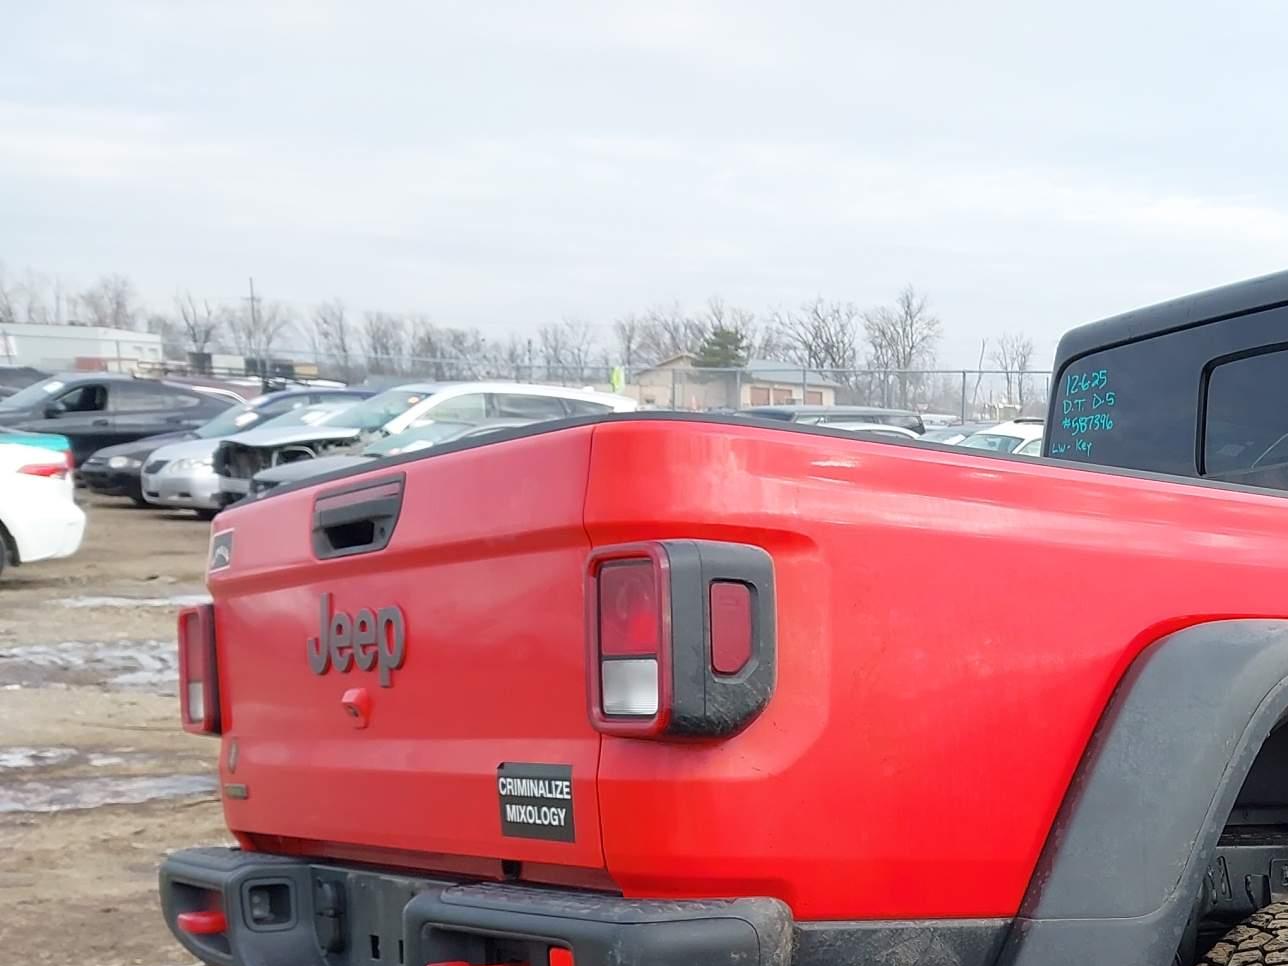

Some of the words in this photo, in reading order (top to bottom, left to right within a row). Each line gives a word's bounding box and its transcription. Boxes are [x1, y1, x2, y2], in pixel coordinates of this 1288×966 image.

[307, 592, 407, 687] Jeep
[498, 777, 572, 800] CRIMINALIZE
[505, 804, 567, 827] MIXOLOGY
